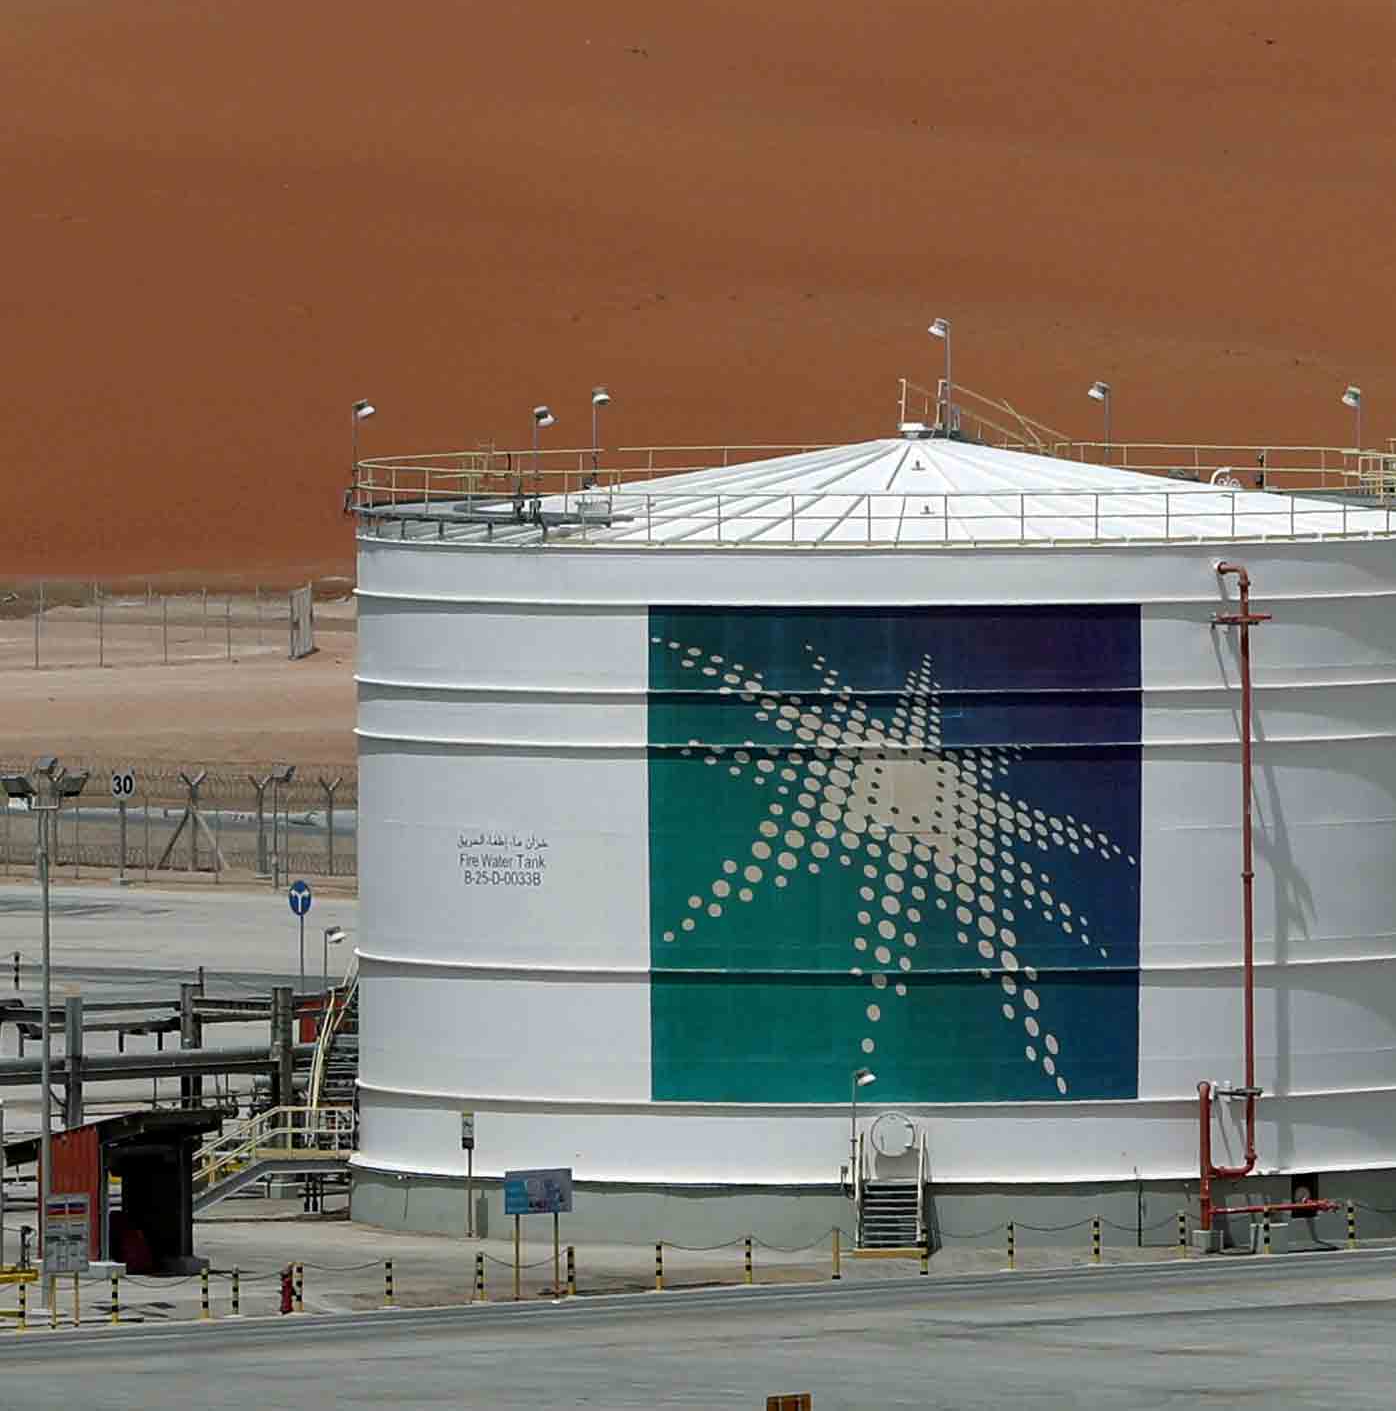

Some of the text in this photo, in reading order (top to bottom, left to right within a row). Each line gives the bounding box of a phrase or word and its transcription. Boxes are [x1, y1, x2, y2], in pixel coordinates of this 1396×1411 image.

[112, 774, 133, 795] 30
[460, 853, 546, 869] Fire Water Tank
